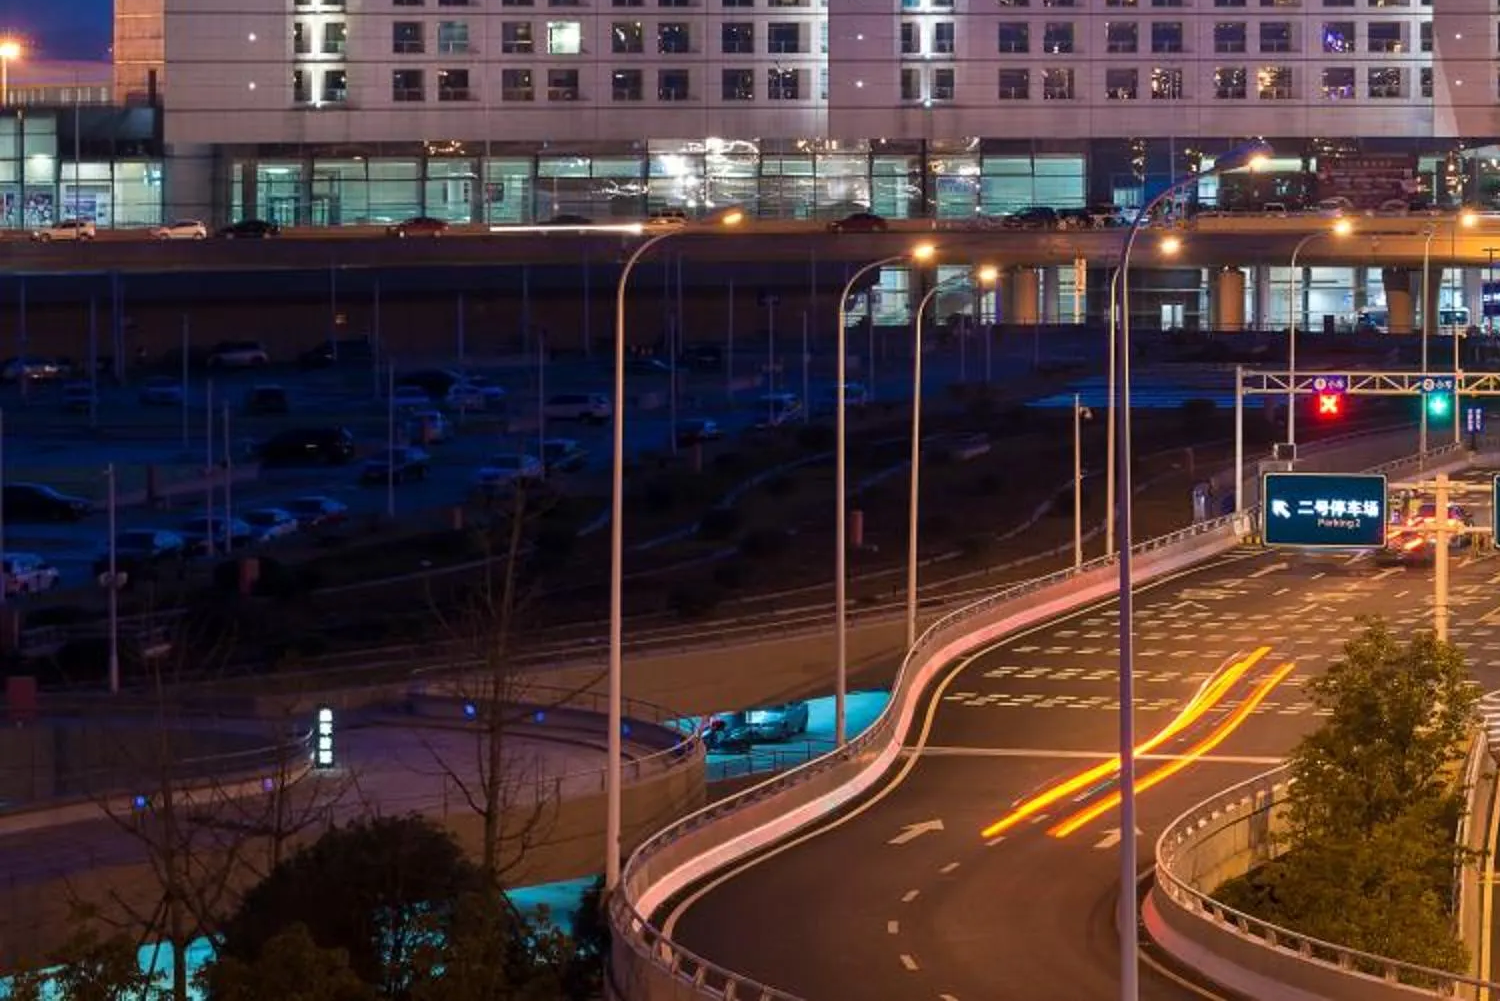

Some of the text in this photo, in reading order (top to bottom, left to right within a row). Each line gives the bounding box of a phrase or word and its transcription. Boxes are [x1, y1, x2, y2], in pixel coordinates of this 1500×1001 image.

[1298, 500, 1379, 517] 二号停车场
